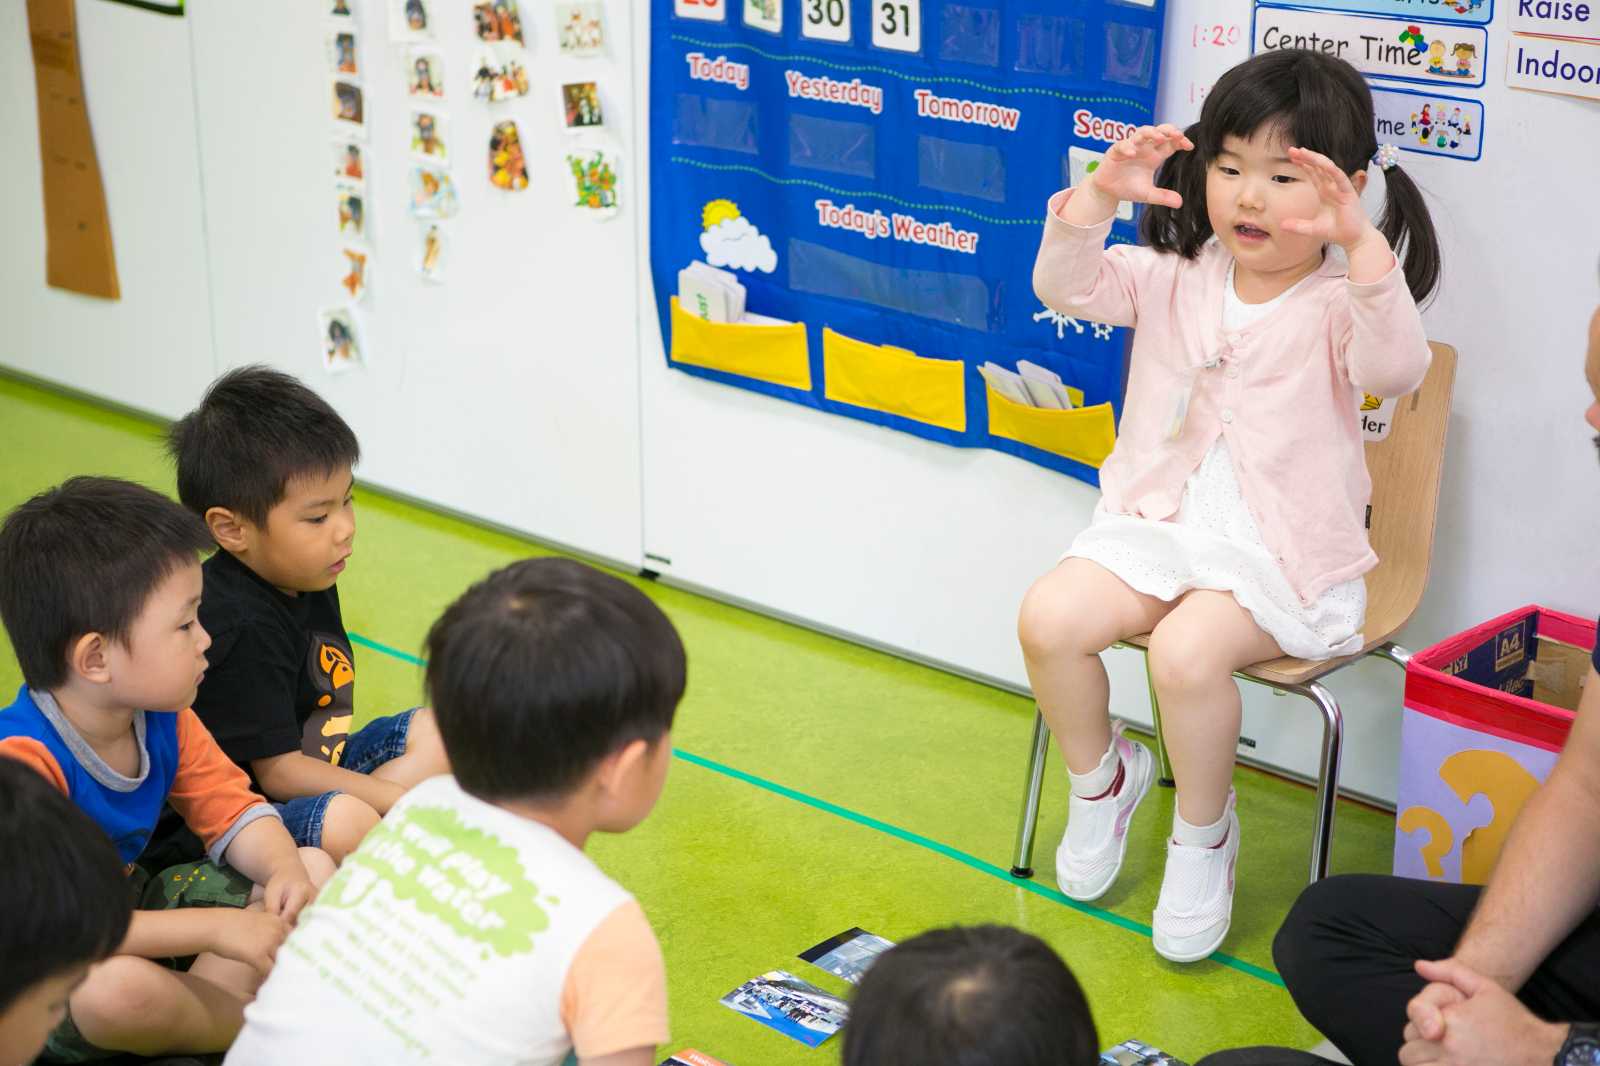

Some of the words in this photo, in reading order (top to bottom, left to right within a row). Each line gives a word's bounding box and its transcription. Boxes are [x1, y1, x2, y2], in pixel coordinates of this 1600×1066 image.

[807, 0, 844, 27] 30
[880, 2, 910, 37] 31
[1518, 0, 1590, 22] Raise
[1192, 23, 1240, 48] 1:20
[1263, 26, 1349, 58] Center
[1359, 35, 1422, 66] Time
[688, 55, 749, 88] Today
[786, 72, 882, 112] Yesterday
[916, 92, 1019, 129] Tomorrow
[1075, 111, 1137, 142] Seaso
[817, 203, 889, 237] Today's
[892, 216, 979, 252] Weather
[1501, 632, 1520, 657] A4
